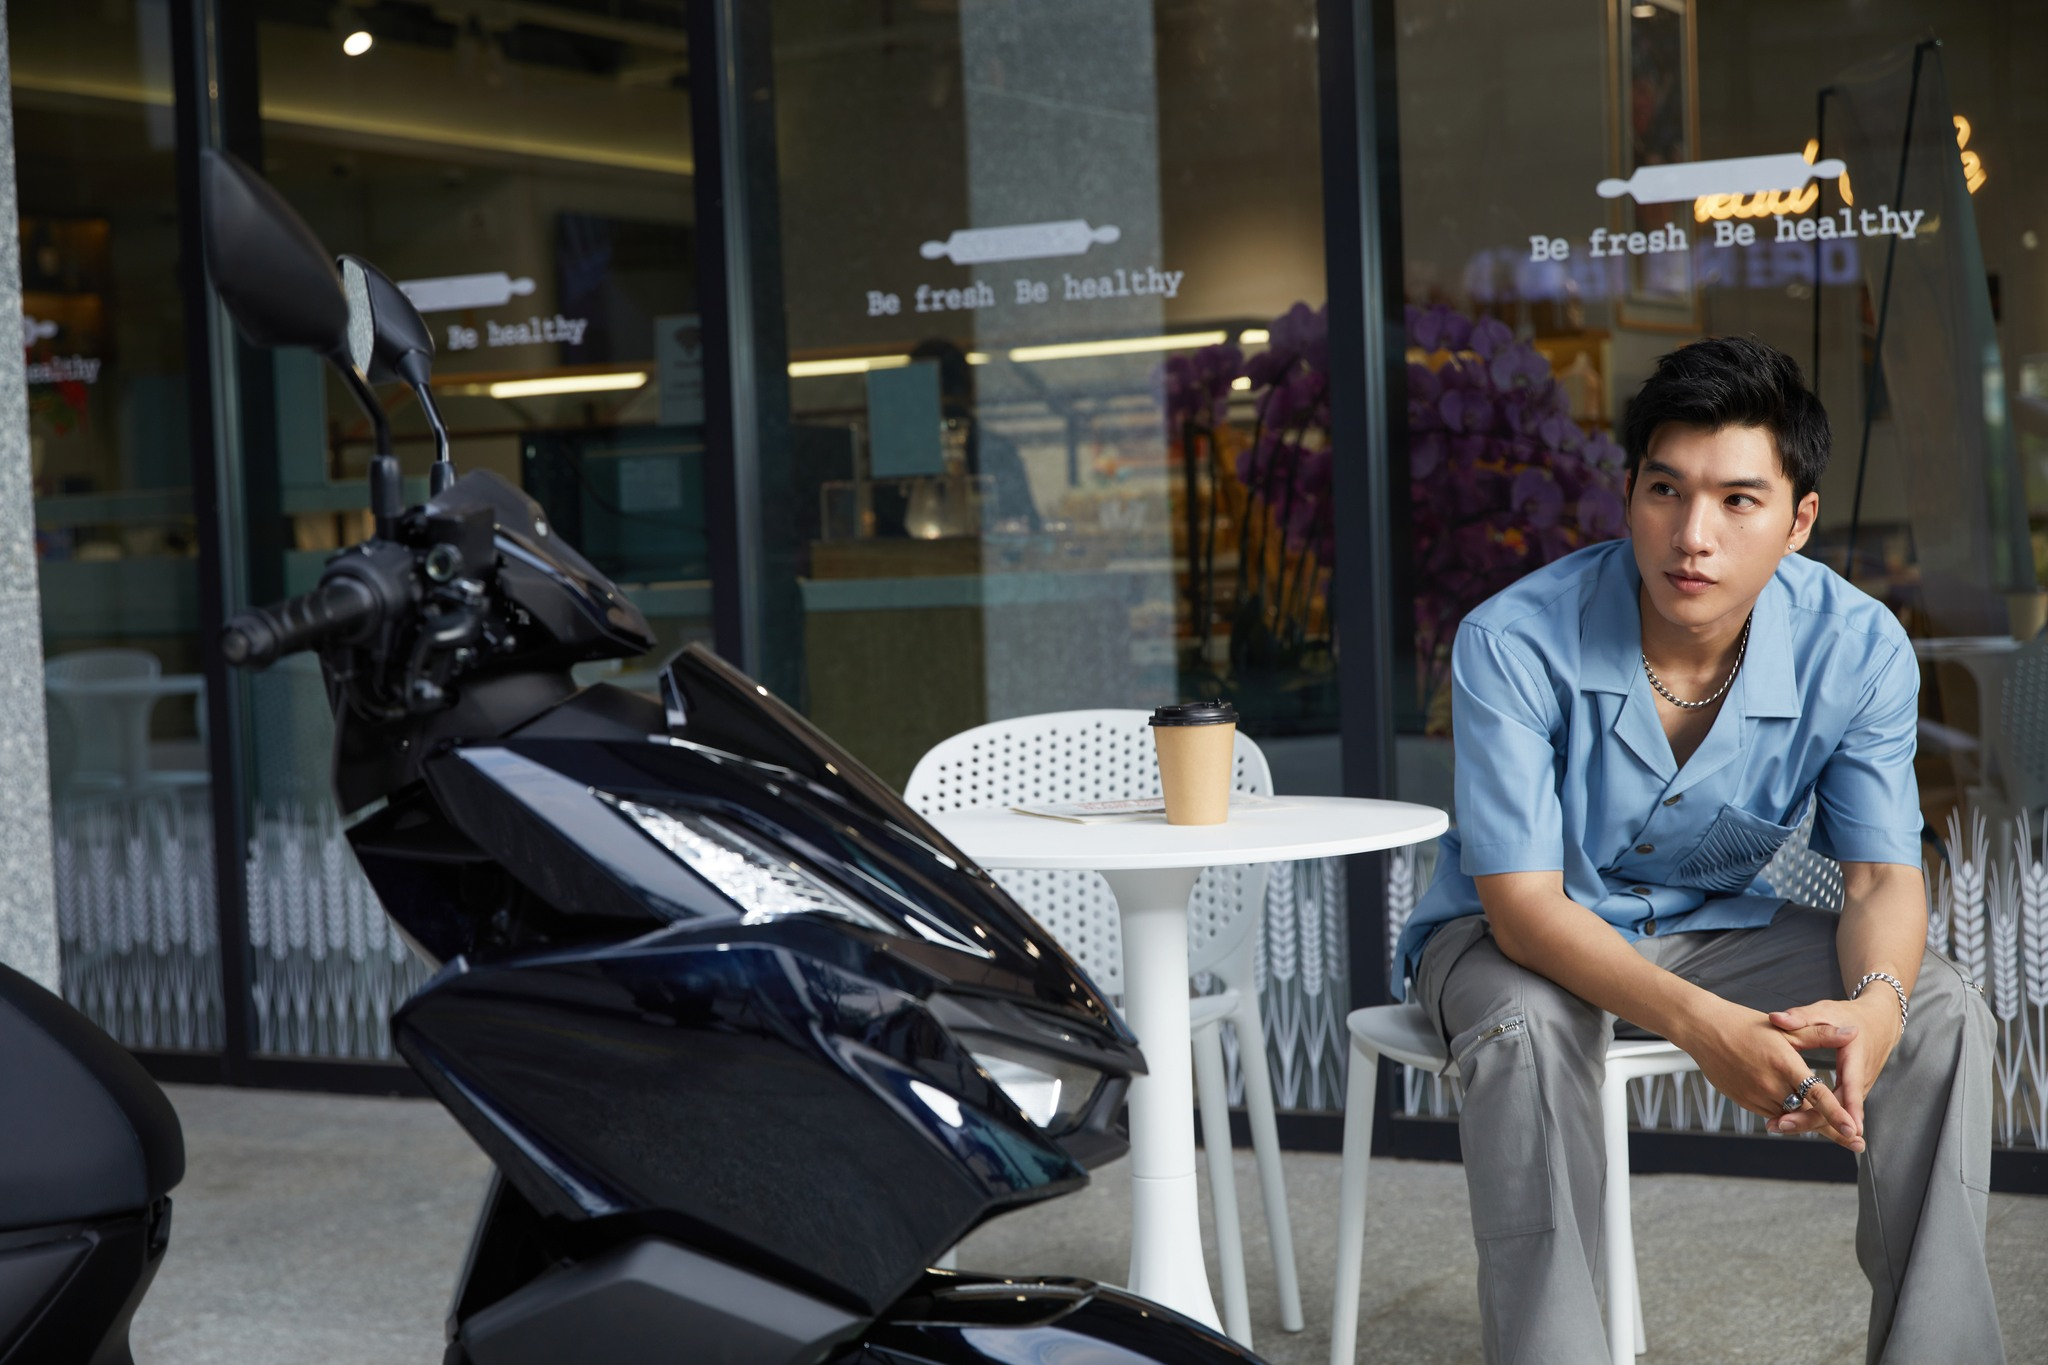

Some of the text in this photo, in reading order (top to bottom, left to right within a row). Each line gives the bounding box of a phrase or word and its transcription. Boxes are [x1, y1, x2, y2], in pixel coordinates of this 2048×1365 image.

[1530, 205, 1924, 263] Be fresh Be healthy
[866, 267, 1184, 316] Be fresh Be healthy
[447, 313, 589, 351] Be healthy
[27, 354, 102, 384] ealthy
